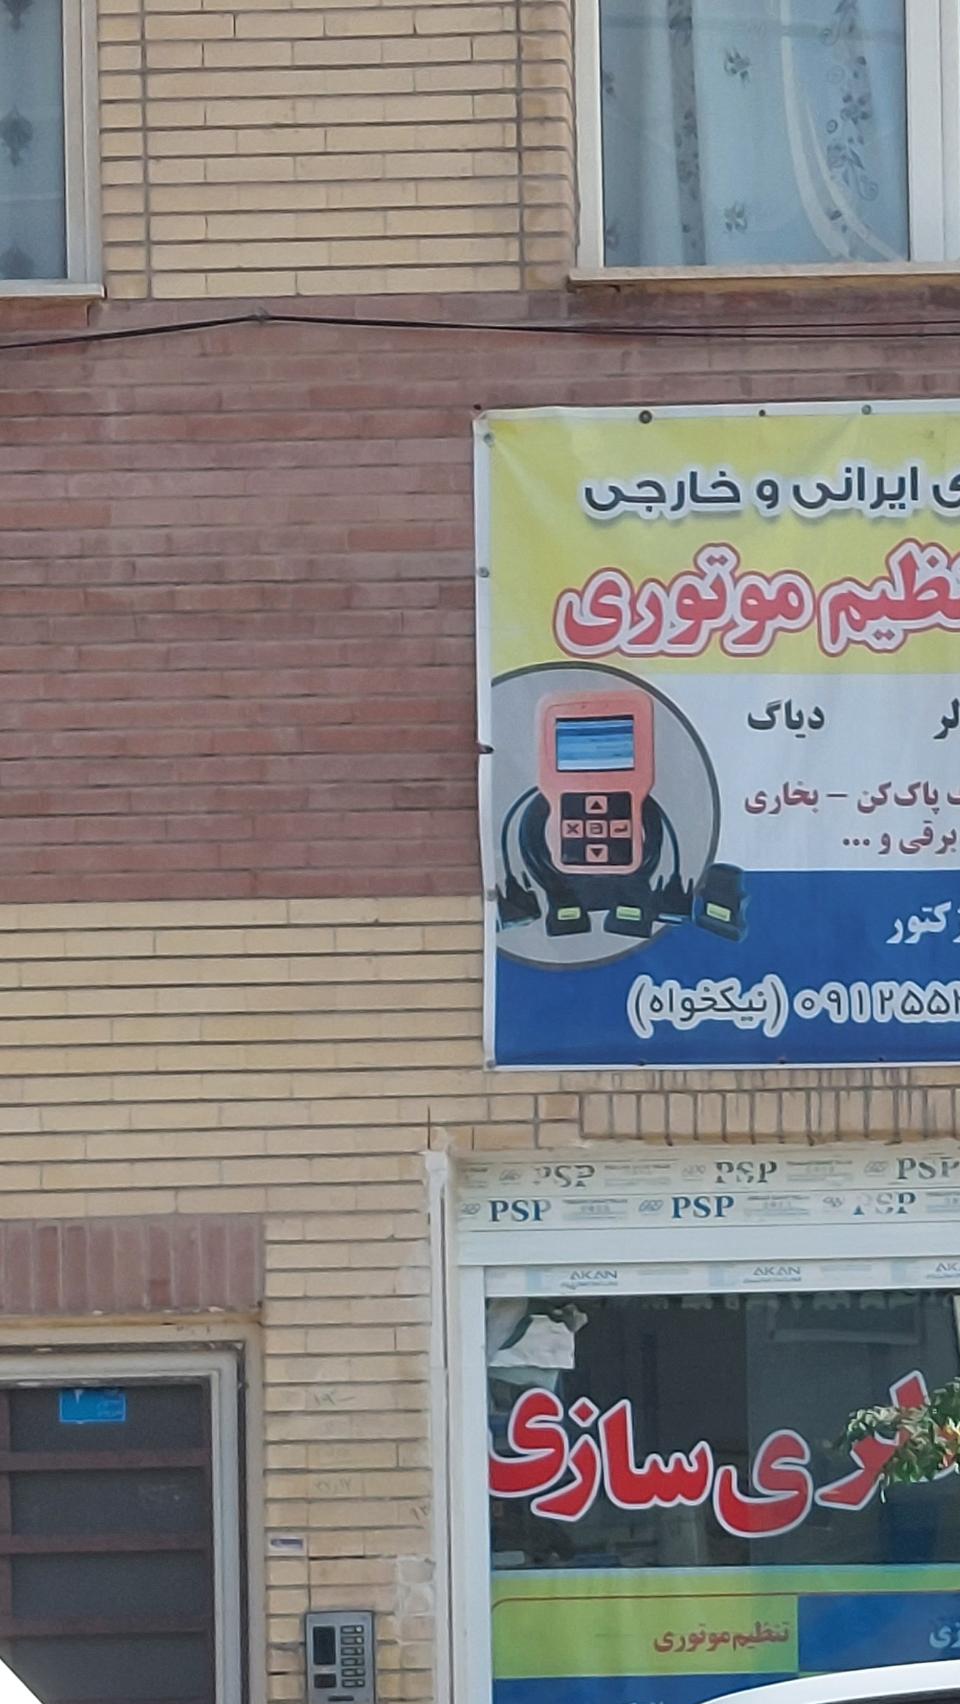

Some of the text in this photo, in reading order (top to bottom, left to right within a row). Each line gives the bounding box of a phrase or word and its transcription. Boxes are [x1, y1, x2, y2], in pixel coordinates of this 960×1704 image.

[584, 469, 741, 513] خارجی
[754, 476, 778, 509] و
[791, 464, 919, 511] ایرانی
[553, 542, 814, 658] موتوری
[745, 697, 826, 739] دیاگ
[743, 779, 820, 815] بخاری
[878, 831, 894, 854] و
[897, 818, 958, 857] برقی
[488, 1199, 552, 1222] PSP
[671, 1194, 735, 1219] PSP
[653, 1621, 791, 1654] تنظیم موتوری
